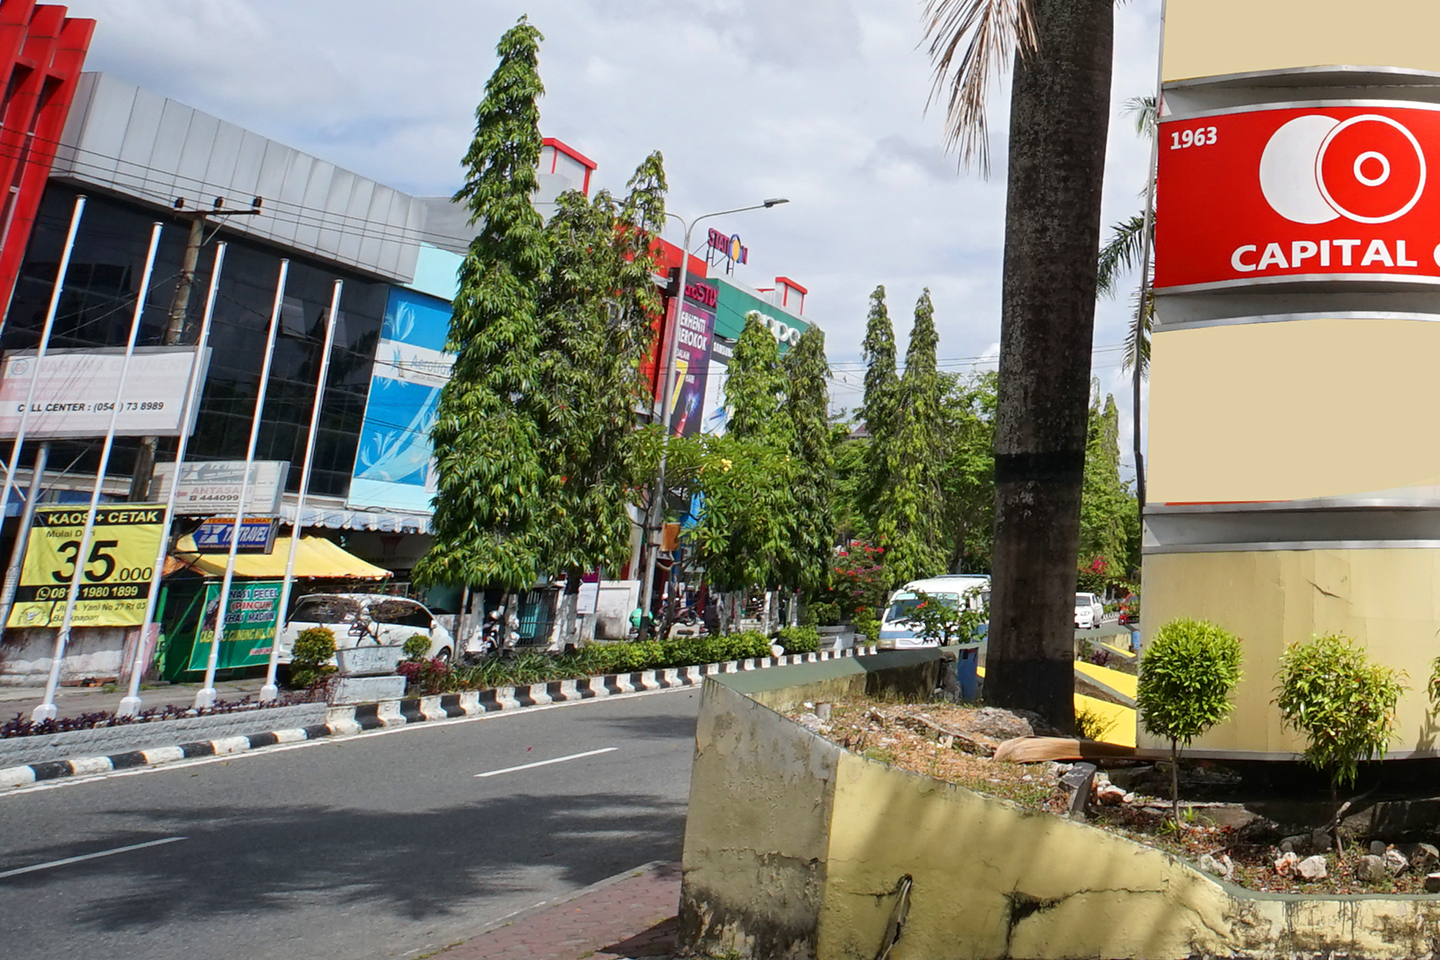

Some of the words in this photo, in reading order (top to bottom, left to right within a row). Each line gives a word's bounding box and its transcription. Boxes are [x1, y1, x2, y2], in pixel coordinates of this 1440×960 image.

[1170, 126, 1218, 150] 1963
[1231, 239, 1418, 272] CAPITAL
[680, 310, 707, 335] ERHENTI
[680, 327, 708, 352] EROKOK
[18, 403, 43, 413] CLL
[46, 403, 86, 412] CENTER
[93, 402, 124, 413] (054)
[127, 402, 139, 411] 73
[141, 401, 165, 411] 8989
[48, 513, 88, 525] KAOS
[108, 511, 159, 523] CETAK
[46, 530, 73, 538] Mulai
[83, 587, 110, 597] 1980
[112, 586, 139, 597] 1899
